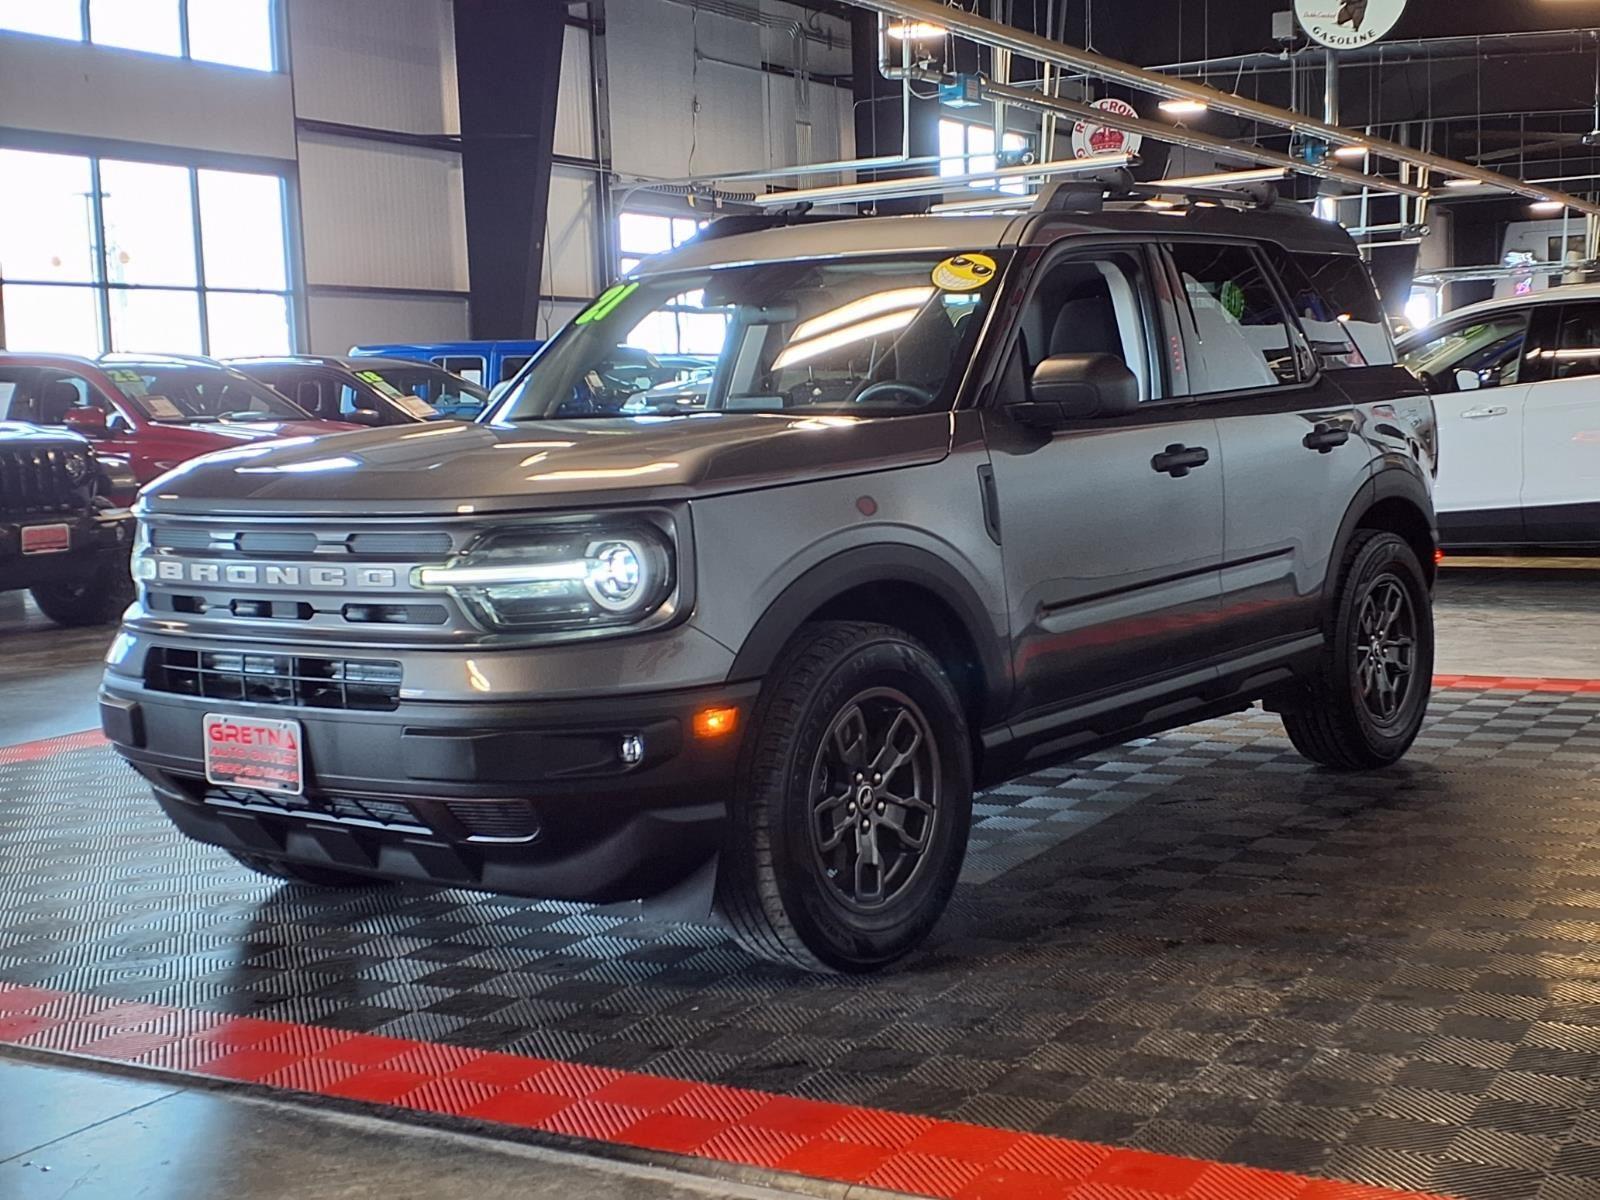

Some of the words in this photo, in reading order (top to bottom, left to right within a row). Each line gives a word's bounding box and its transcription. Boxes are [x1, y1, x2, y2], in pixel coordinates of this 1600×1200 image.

[1312, 26, 1377, 46] GASOLINE
[575, 282, 640, 325] 21
[158, 560, 397, 588] BRONCO
[208, 723, 297, 750] GRETNA
